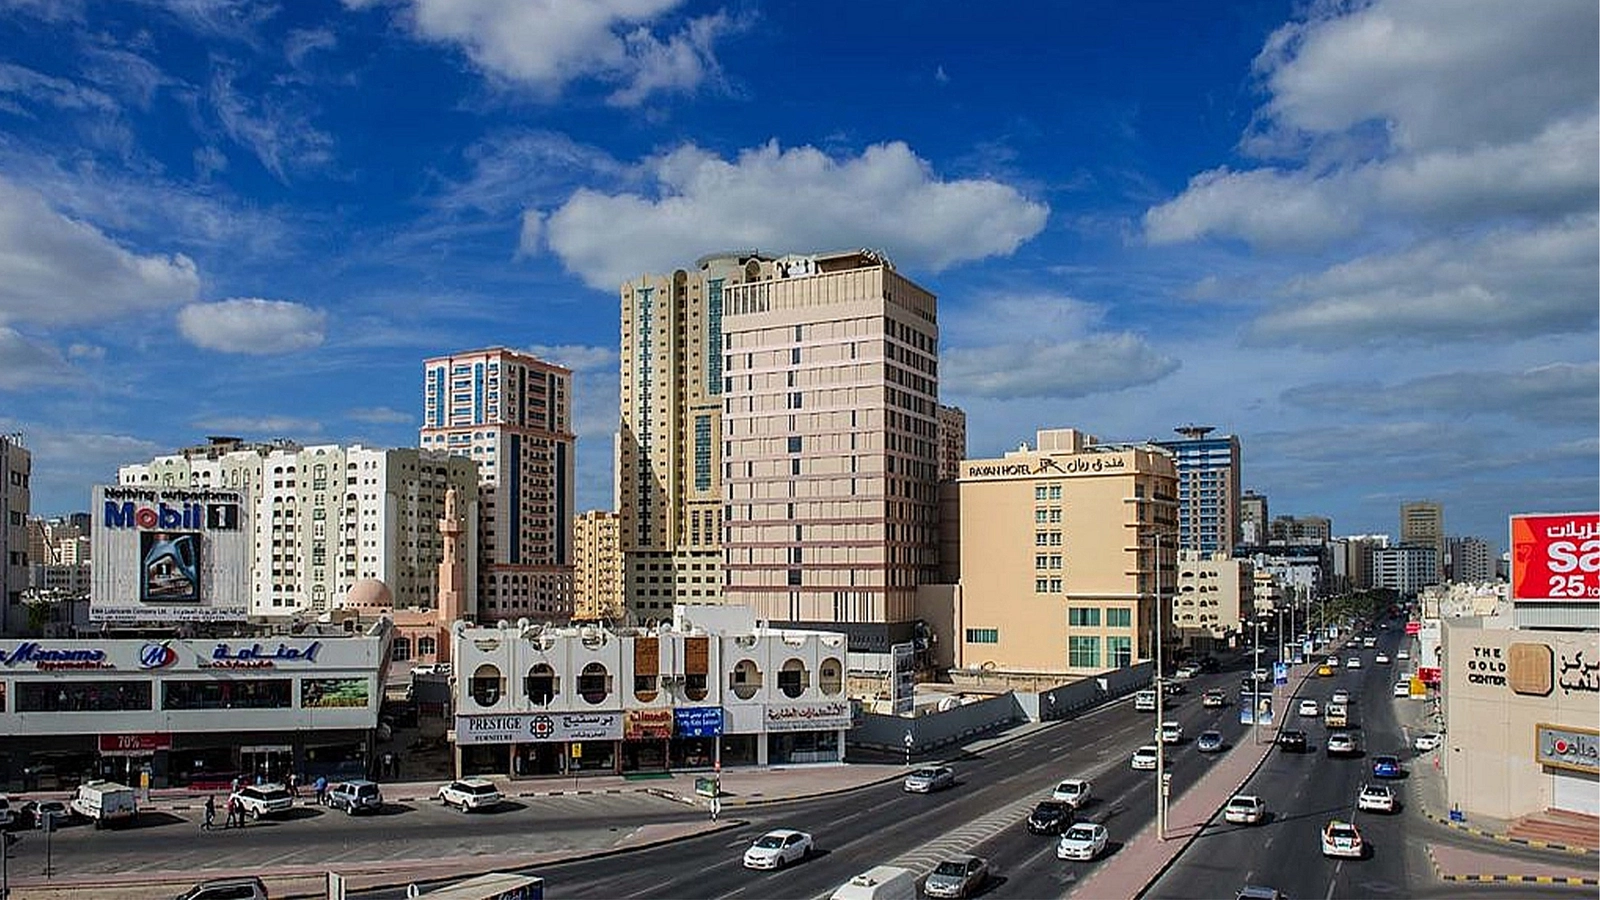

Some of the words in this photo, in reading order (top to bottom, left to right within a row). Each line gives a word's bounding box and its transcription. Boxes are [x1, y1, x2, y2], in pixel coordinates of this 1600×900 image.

[970, 466, 1000, 477] RAYAN
[1004, 464, 1031, 476] HOTEL
[1067, 458, 1089, 473] ريان
[1092, 457, 1125, 472] فندق
[105, 488, 155, 501] Nothing
[161, 490, 239, 501] outperforms
[105, 502, 202, 529] Mobil
[1549, 575, 1585, 597] 25
[1587, 586, 1599, 597] to
[5, 642, 105, 665] Manama
[1474, 648, 1501, 658] THE
[1468, 661, 1506, 672] GOLD
[1469, 674, 1506, 686] CENTER
[470, 717, 521, 730] PRESTIGE
[118, 735, 140, 748] 70%
